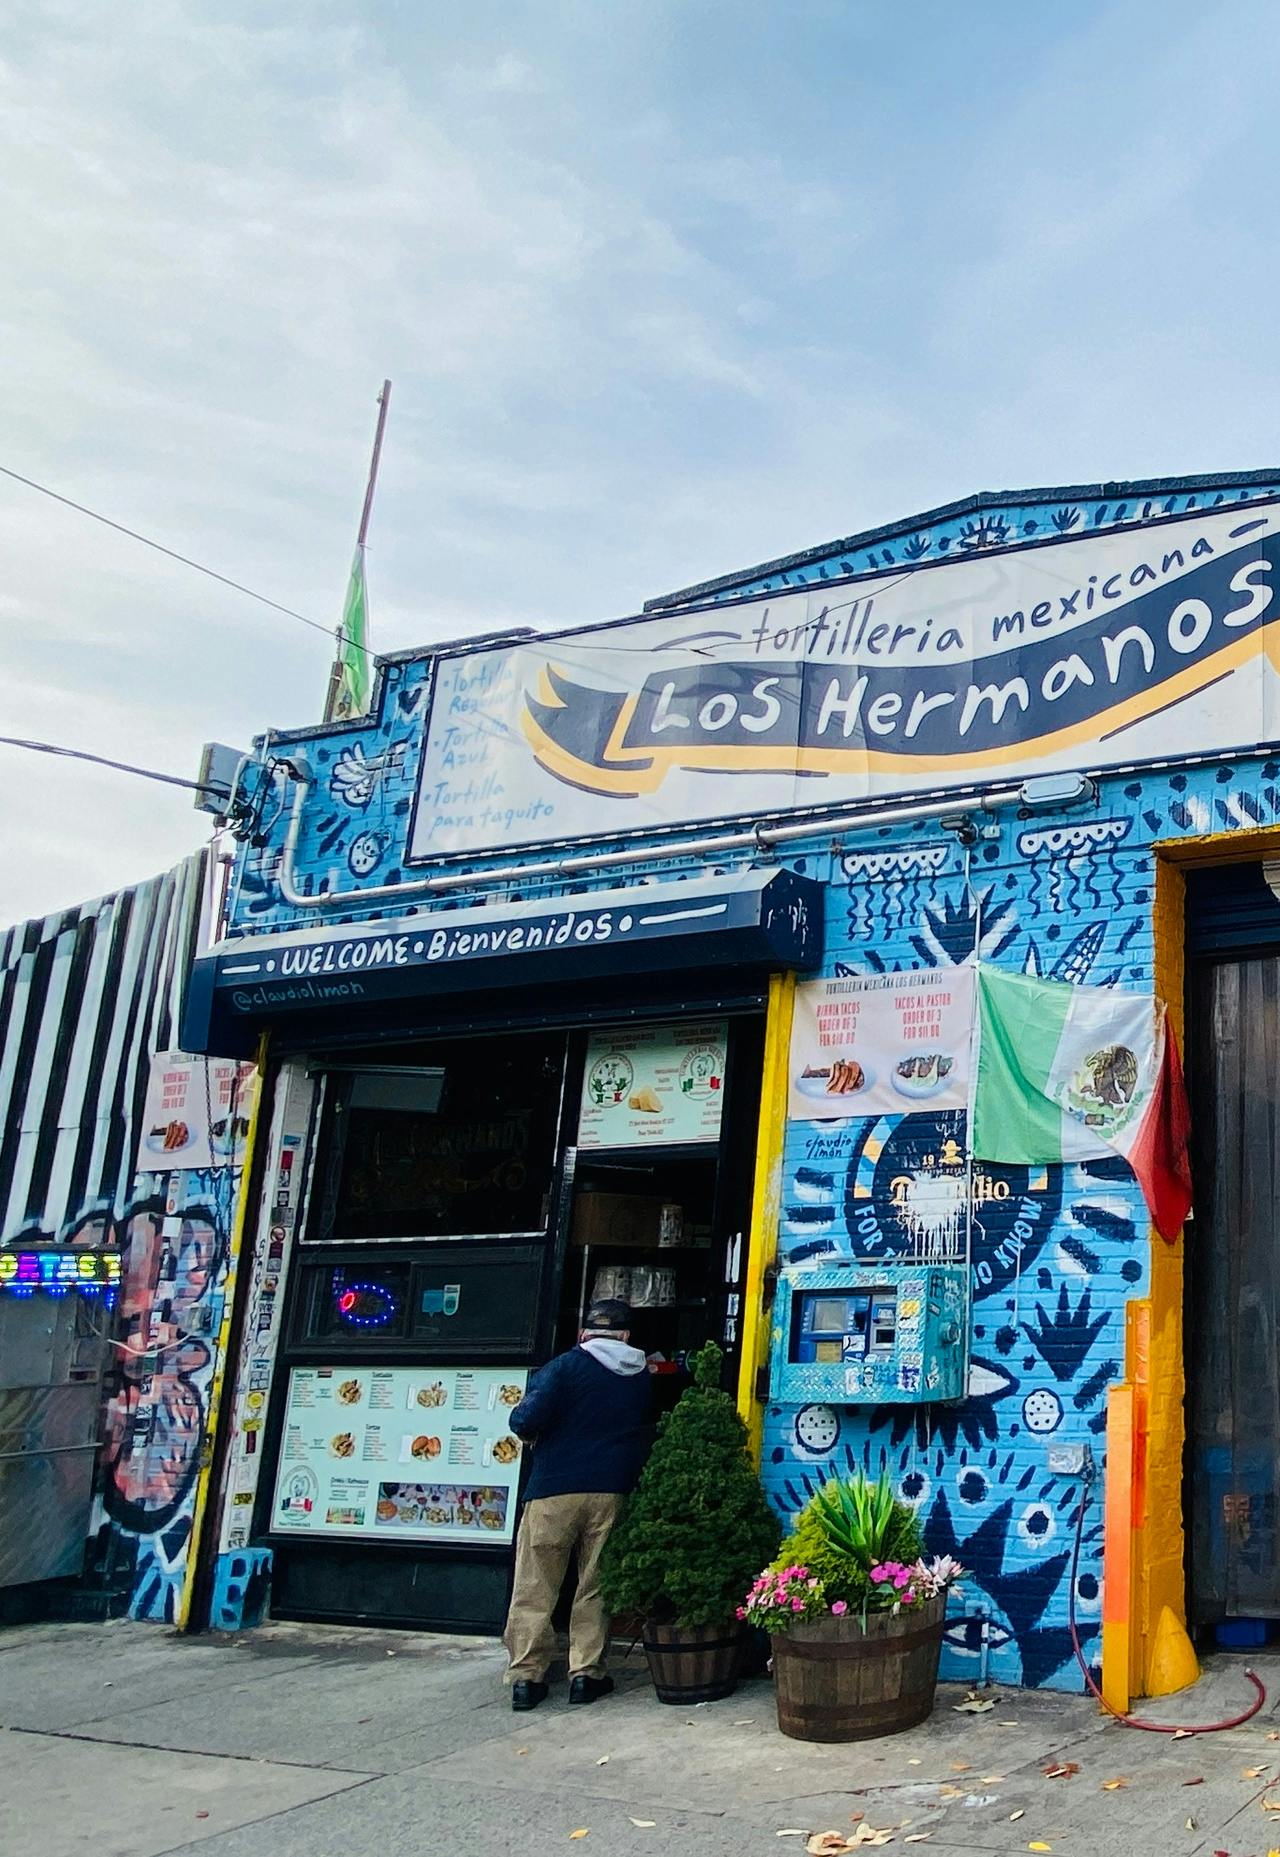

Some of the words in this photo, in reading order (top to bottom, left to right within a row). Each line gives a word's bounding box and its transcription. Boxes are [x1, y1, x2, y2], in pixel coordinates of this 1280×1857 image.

[751, 599, 965, 656] tortilleria
[992, 536, 1215, 642] mexicana
[442, 719, 509, 752] Tortia
[433, 769, 505, 808] Tortilla
[427, 815, 474, 841] para
[479, 797, 555, 830] taquito
[281, 936, 410, 976] WELCOME
[426, 912, 613, 960] Bienvenidos
[894, 996, 916, 1010] TACOS
[916, 995, 926, 1008] AL
[926, 993, 951, 1008] PASTOR
[902, 1011, 925, 1025] ORDER
[903, 1026, 917, 1040] FOR
[854, 1203, 884, 1252] FOR
[992, 1195, 1044, 1271] KNOW
